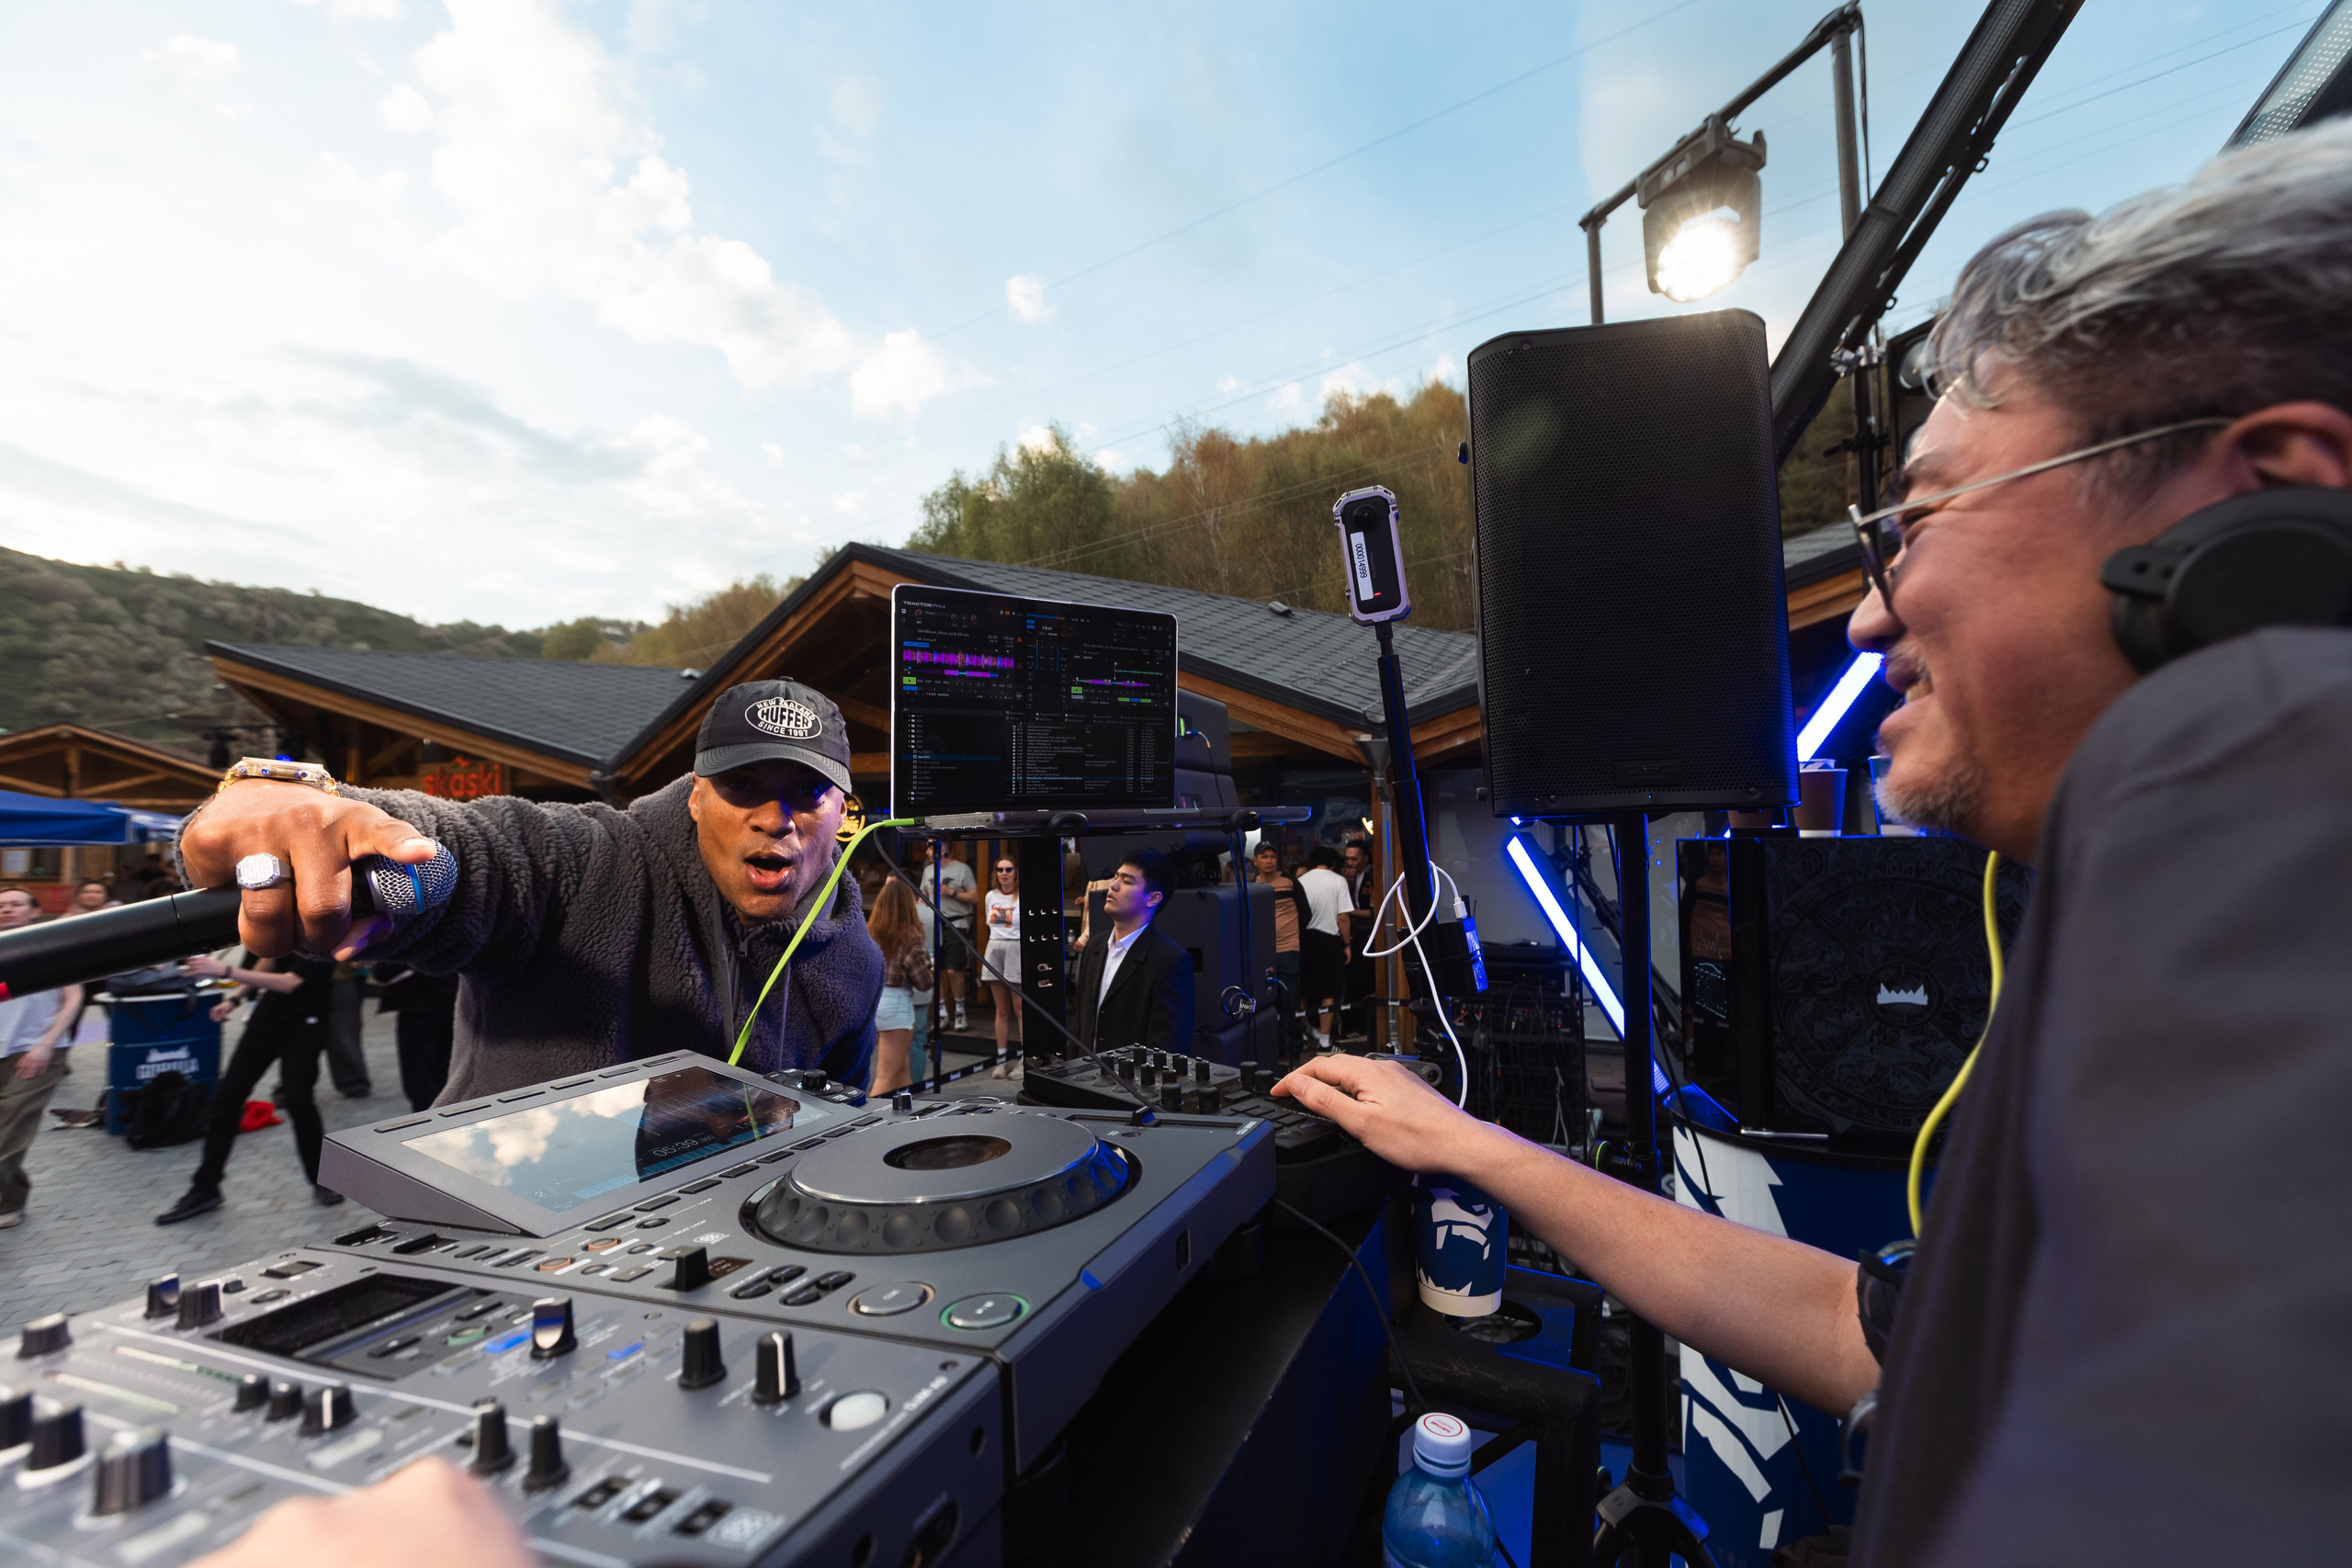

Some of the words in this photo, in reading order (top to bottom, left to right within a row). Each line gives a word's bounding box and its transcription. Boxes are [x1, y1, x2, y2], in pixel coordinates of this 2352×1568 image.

[1355, 543, 1367, 579] 000014999
[756, 700, 776, 709] NEW
[779, 699, 816, 721] ZEALAND
[761, 706, 810, 728] HUFFER
[758, 721, 786, 735] SINCE
[653, 1139, 698, 1156] 05:39
